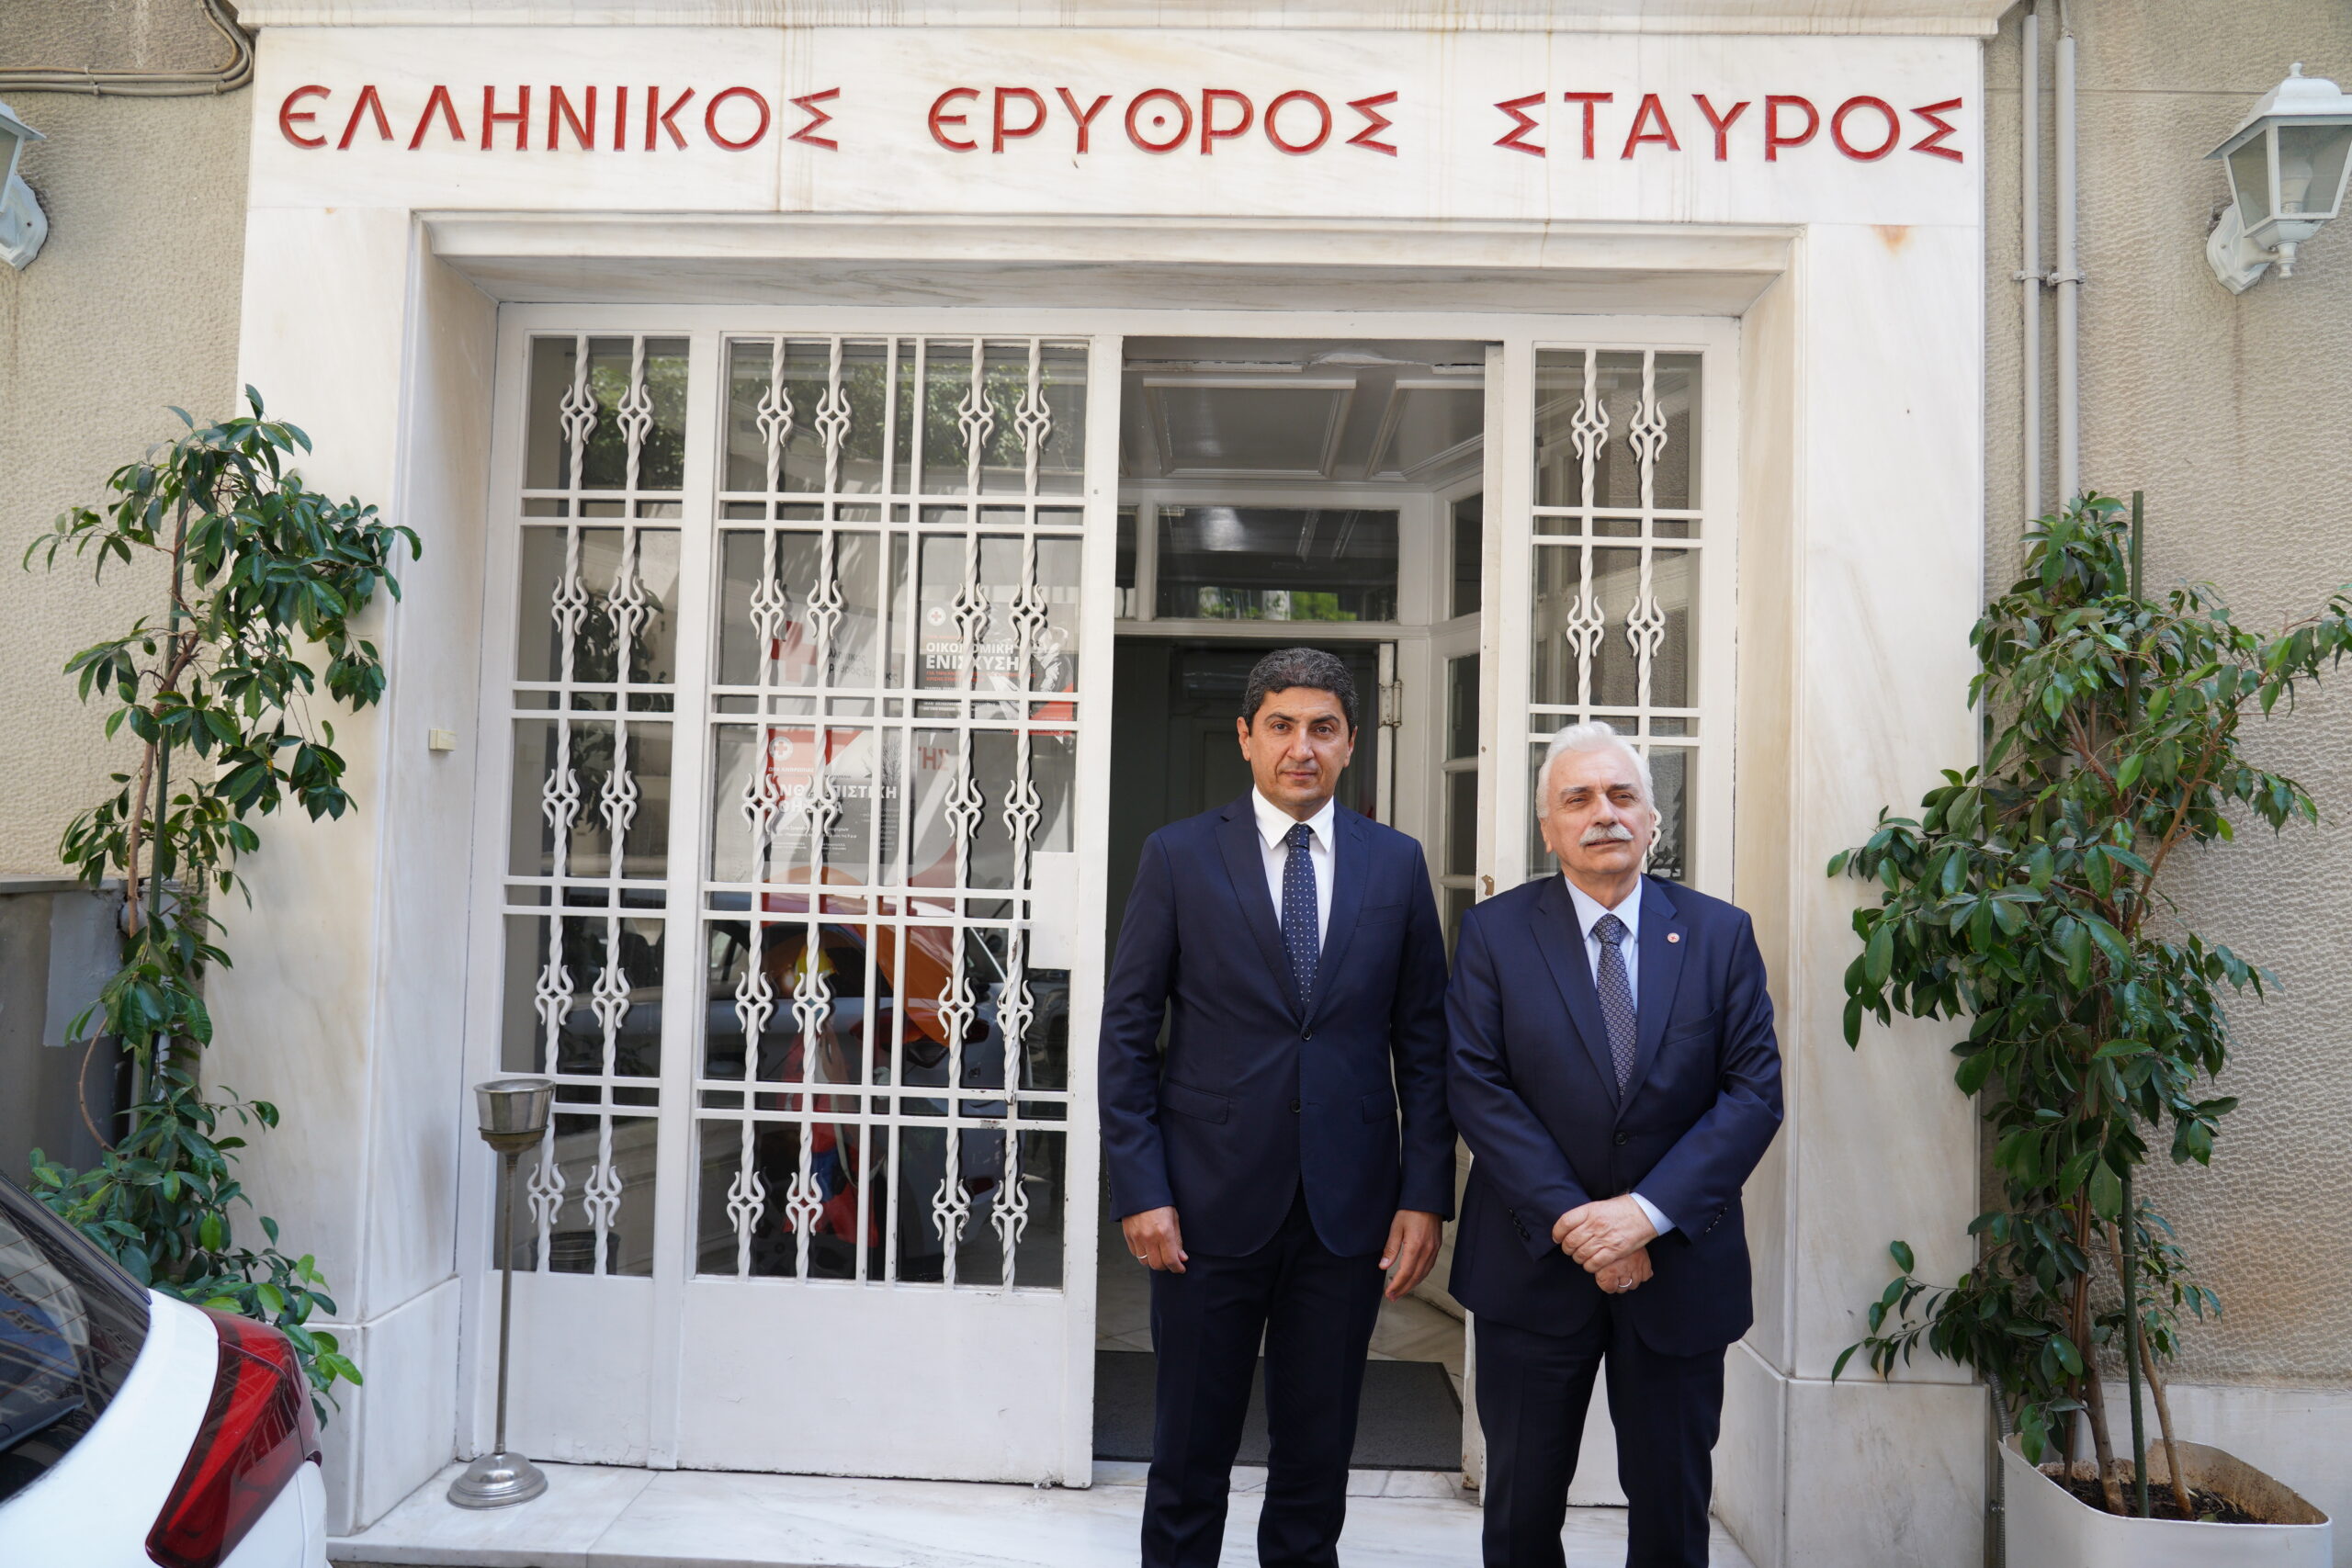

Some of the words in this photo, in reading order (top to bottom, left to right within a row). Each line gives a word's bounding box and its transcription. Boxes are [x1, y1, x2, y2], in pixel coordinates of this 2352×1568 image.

[278, 85, 841, 152] ΕΛΛΗΝΙΚΟΣ
[928, 86, 1398, 156] ΕΡΥΘΡΟΣ
[1493, 92, 1963, 164] ΣΤΑΥΡΟΣ
[926, 642, 1014, 654] ΟΙΚΟΟΜΙΚΗ
